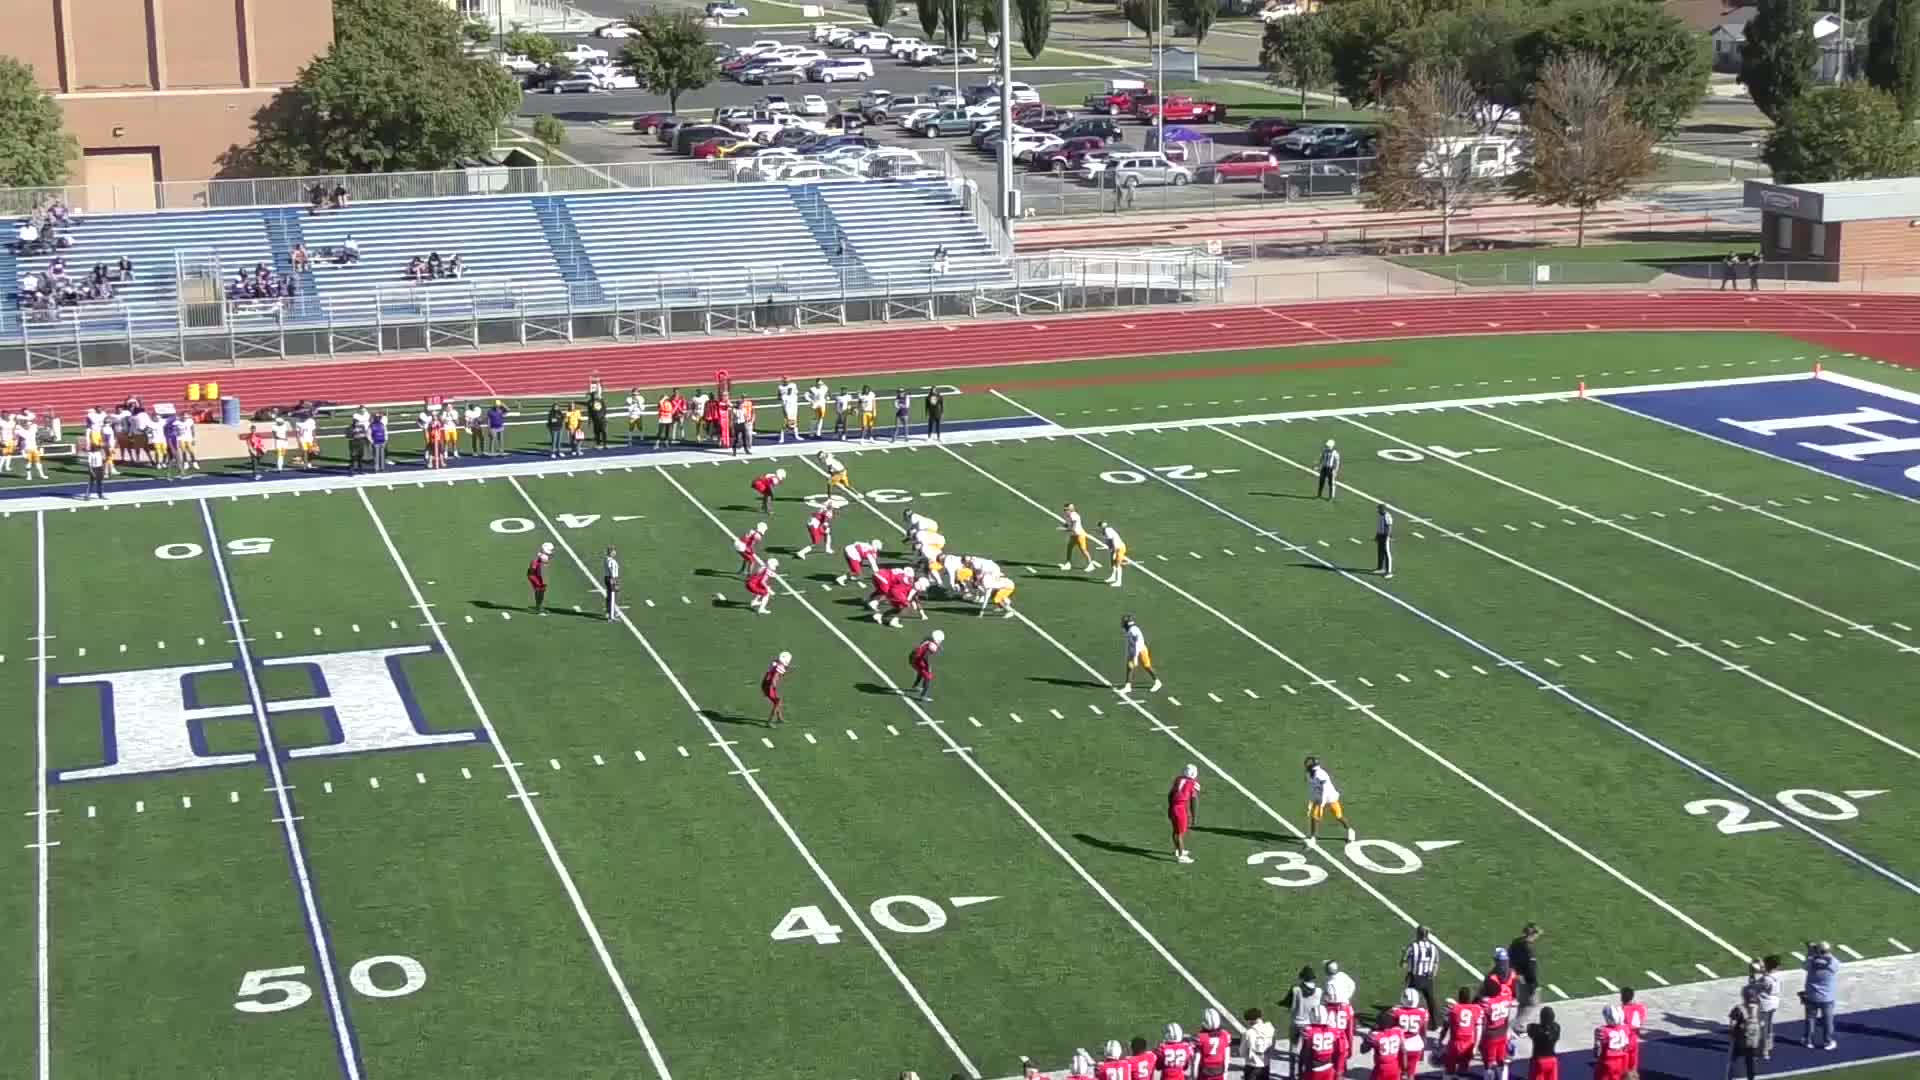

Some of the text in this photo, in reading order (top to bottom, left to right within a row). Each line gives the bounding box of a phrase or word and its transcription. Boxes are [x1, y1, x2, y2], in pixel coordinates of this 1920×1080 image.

[1099, 465, 1210, 485] 20
[489, 513, 603, 534] 40
[154, 537, 275, 560] 50
[53, 643, 488, 782] H
[1684, 789, 1859, 835] 20
[1247, 837, 1424, 887] 30
[770, 894, 948, 945] 40
[233, 955, 427, 1013] 50
[1398, 1014, 1421, 1034] 95
[1459, 1009, 1473, 1027] 9
[1208, 1036, 1220, 1055] 7
[1312, 1032, 1335, 1052] 92
[1379, 1034, 1401, 1056] 32
[1164, 1048, 1187, 1066] 22
